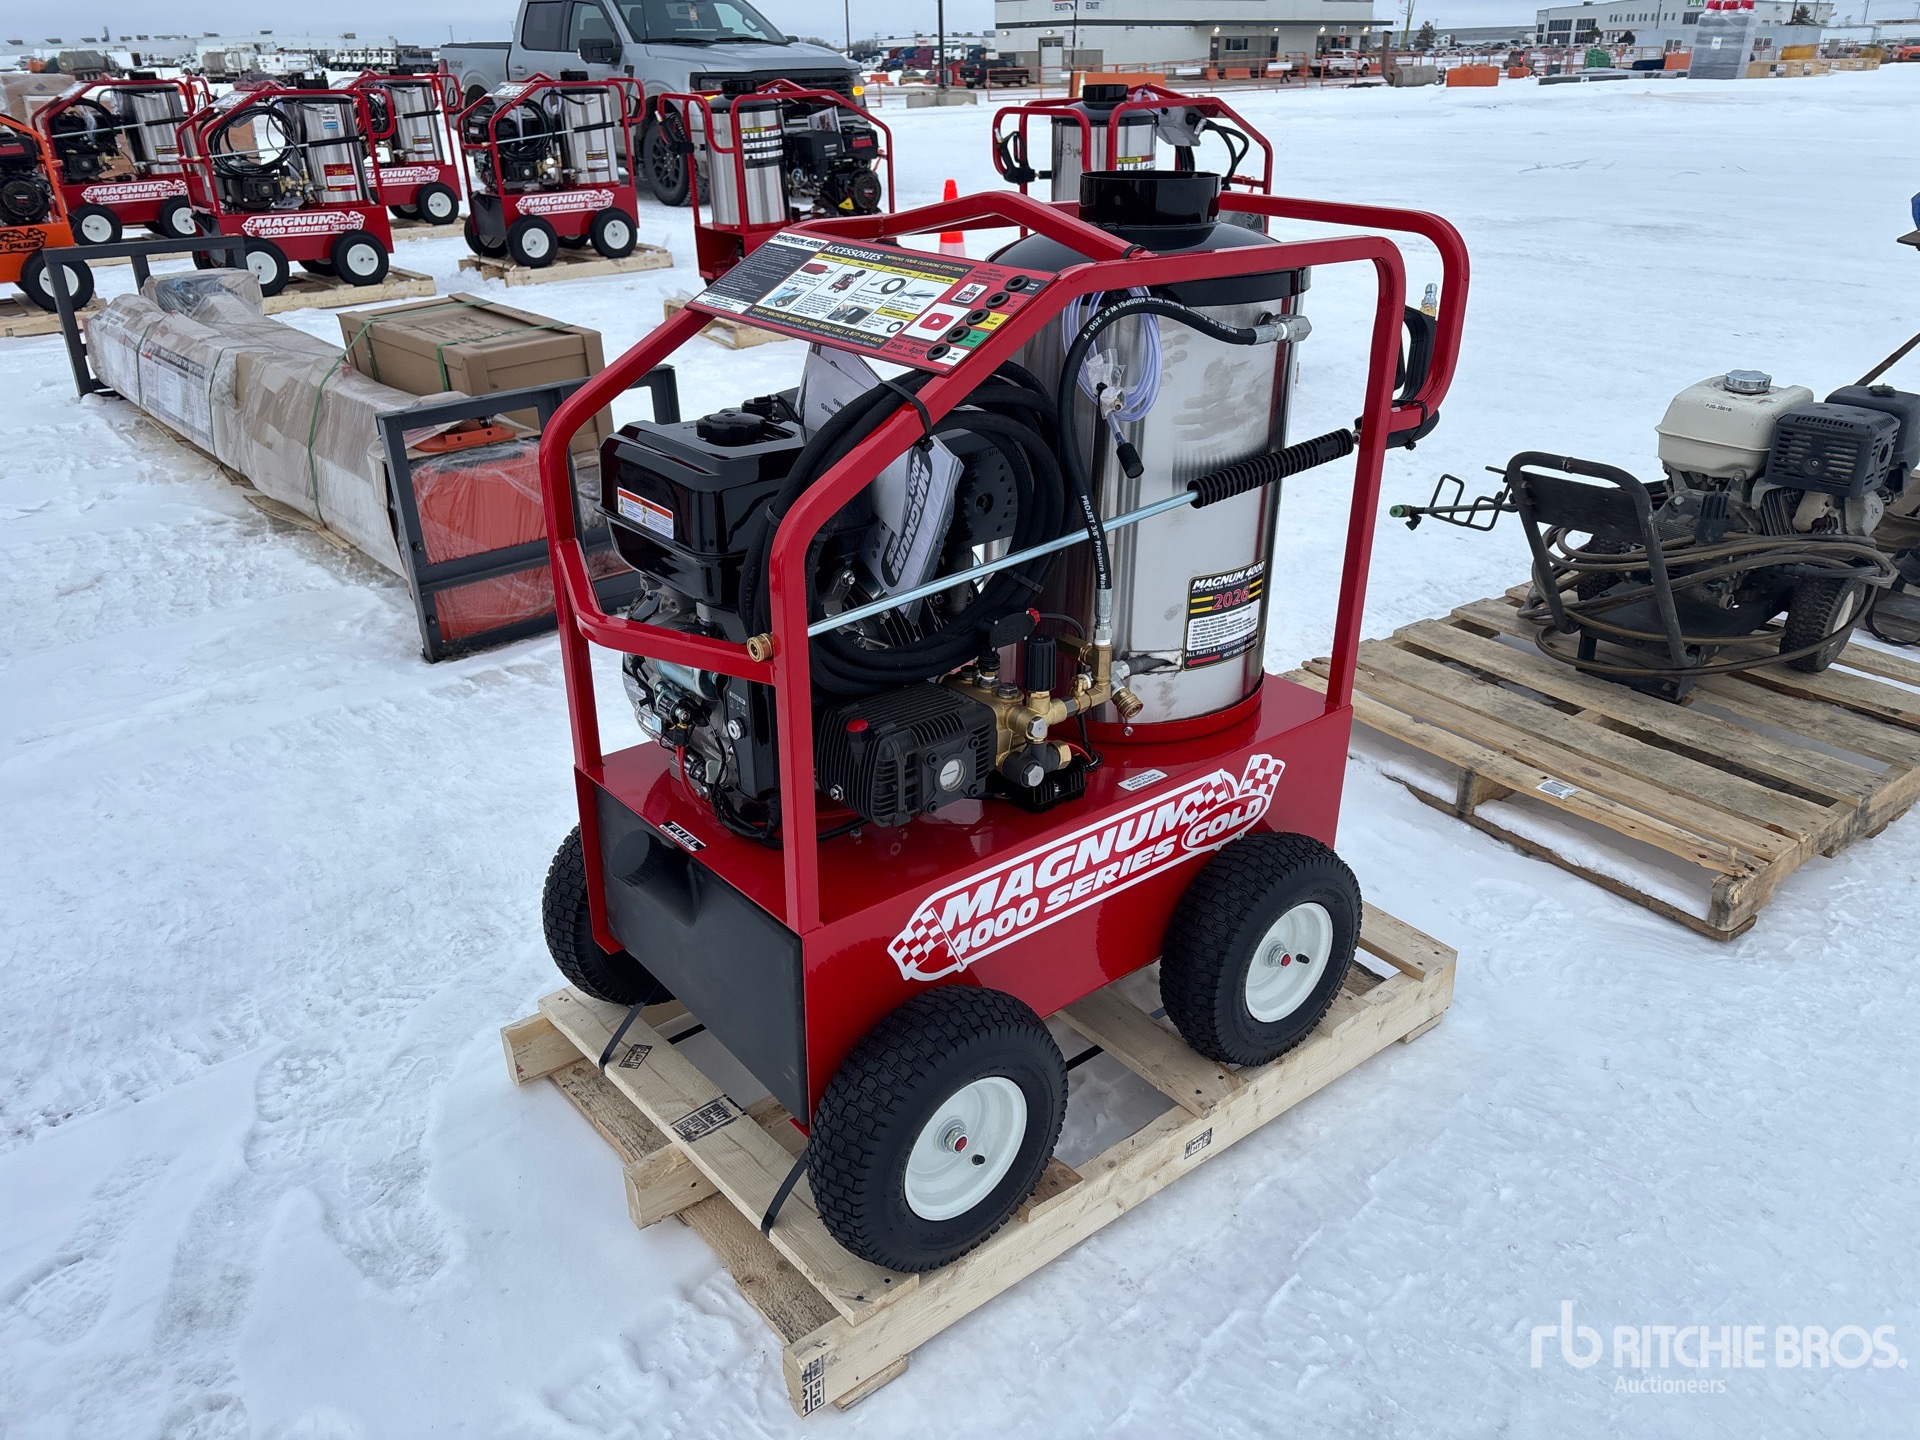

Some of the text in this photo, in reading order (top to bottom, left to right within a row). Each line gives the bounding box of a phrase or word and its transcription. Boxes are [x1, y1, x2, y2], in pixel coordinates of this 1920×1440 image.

[92, 184, 160, 195] MAGNUM
[526, 194, 589, 206] MAGNUM
[255, 215, 333, 227] MAGNUM
[287, 225, 329, 233] SERIES
[10, 242, 40, 250] PLUS
[822, 244, 885, 260] ACCESSORIES
[939, 264, 969, 272] EFFICIENCY
[1119, 298, 1146, 309] 4500PSI
[753, 307, 767, 316] EVERY
[768, 311, 787, 320] MACHINE
[1089, 316, 1103, 330] 250
[891, 462, 930, 582] MAGNUM
[1081, 494, 1095, 524] PROJET
[1095, 540, 1104, 572] Pressure
[1192, 561, 1264, 589] MAGNUM 4000
[1212, 586, 1248, 610] 2026
[1217, 639, 1243, 651] ACCESSORIES
[668, 824, 697, 848] FUEL
[942, 792, 1203, 931] MAGNUM
[947, 798, 1263, 957] 4000 SERIES GOLD
